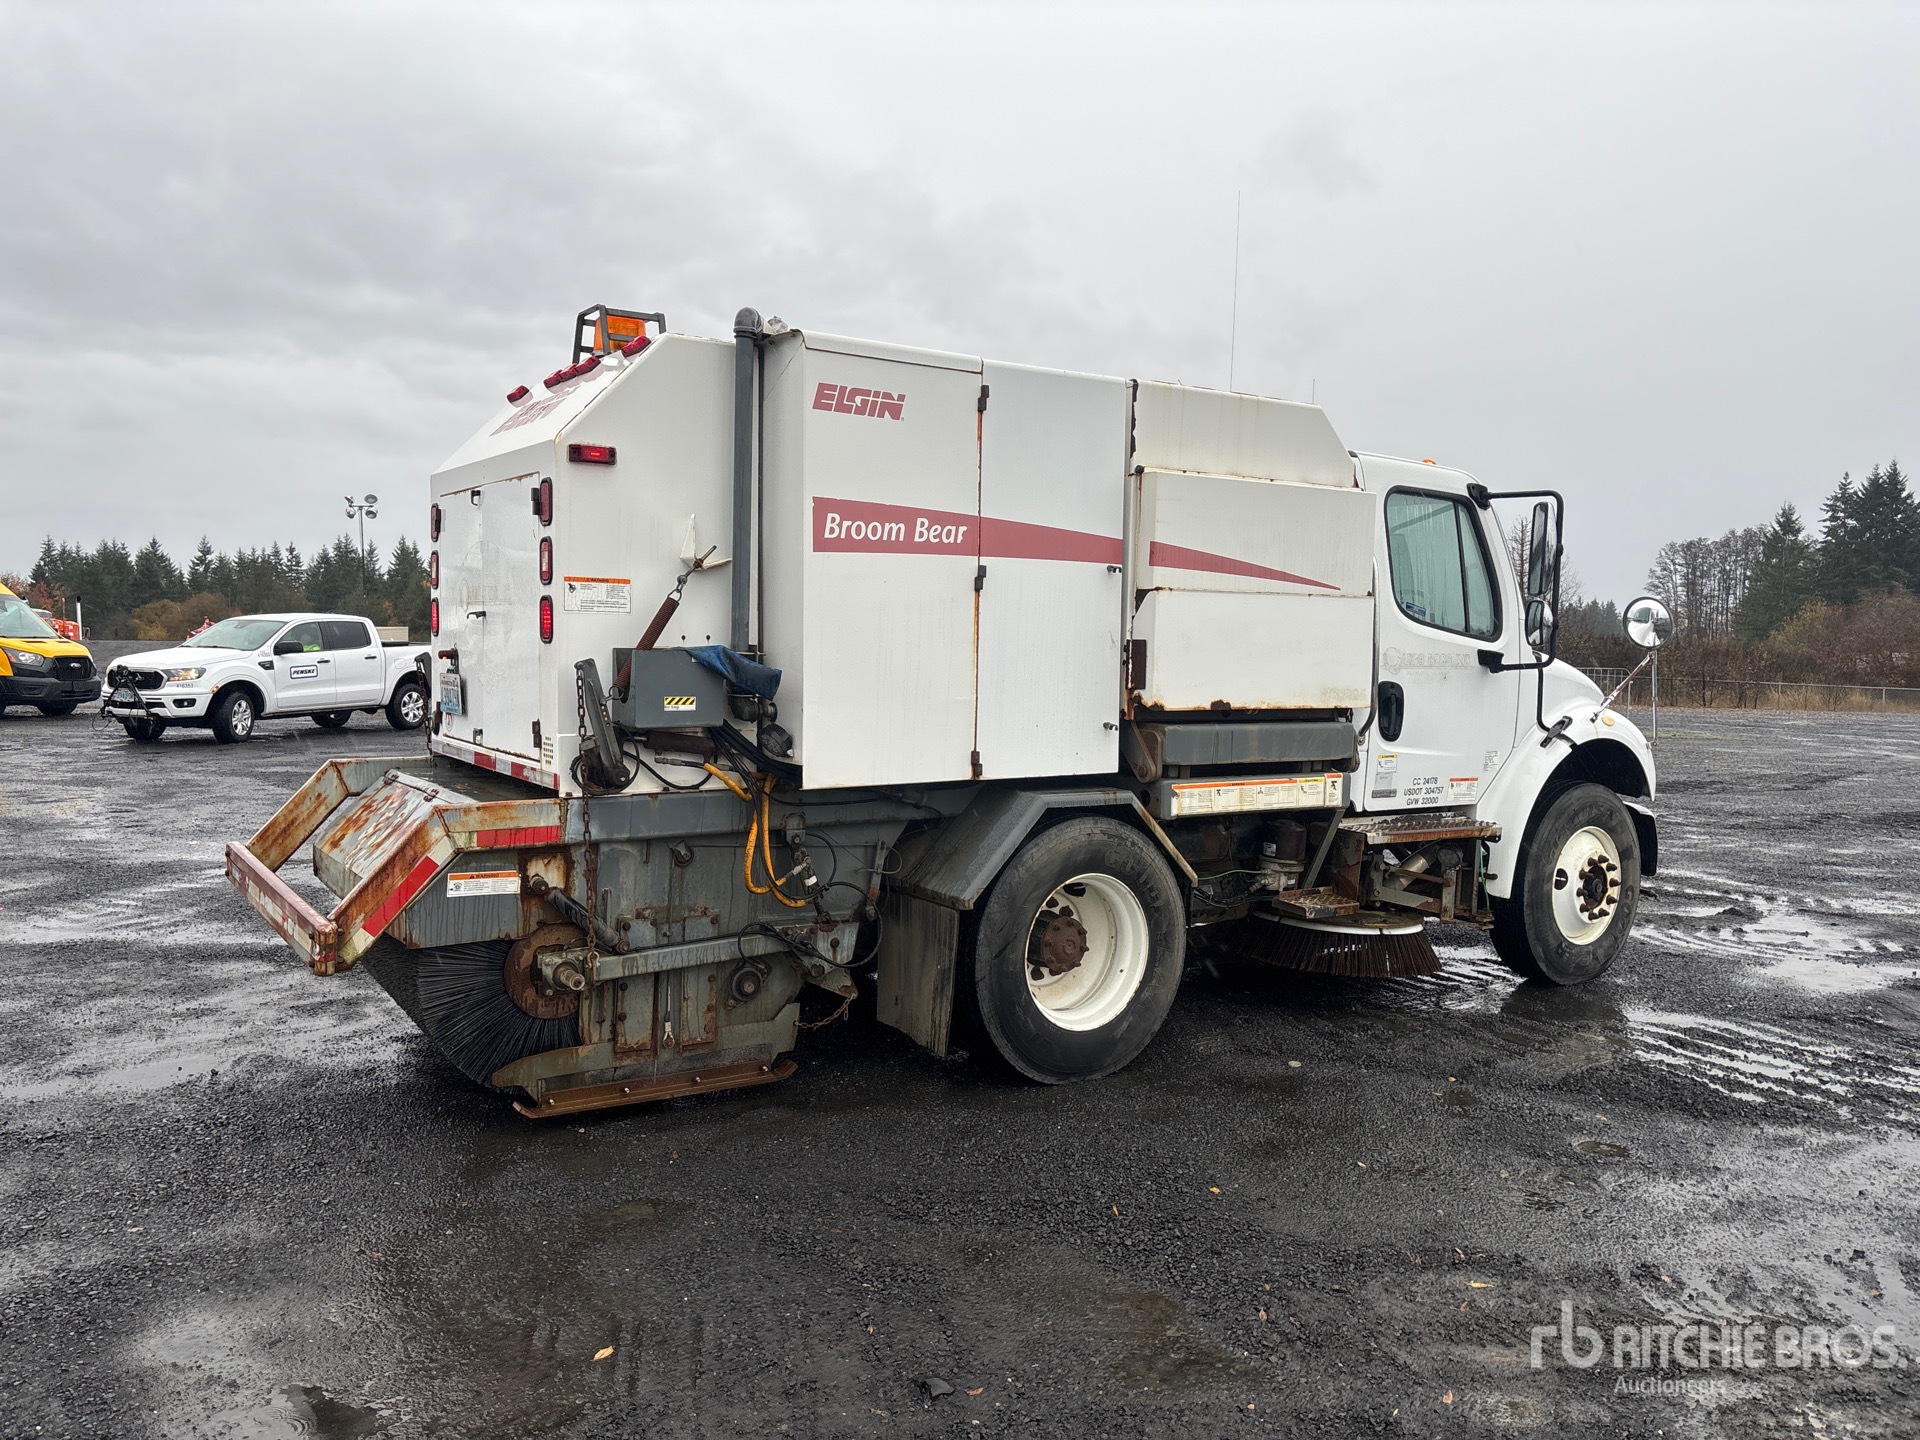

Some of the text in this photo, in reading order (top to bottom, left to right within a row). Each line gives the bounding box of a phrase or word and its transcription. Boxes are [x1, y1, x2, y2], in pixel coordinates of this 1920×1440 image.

[812, 382, 906, 421] ELGIN
[824, 513, 968, 544] Broom Bear
[1412, 776, 1438, 786] CC 24178
[1403, 787, 1423, 796] USDOT
[1424, 786, 1444, 795] 304757
[1406, 796, 1438, 806] GVW 32000
